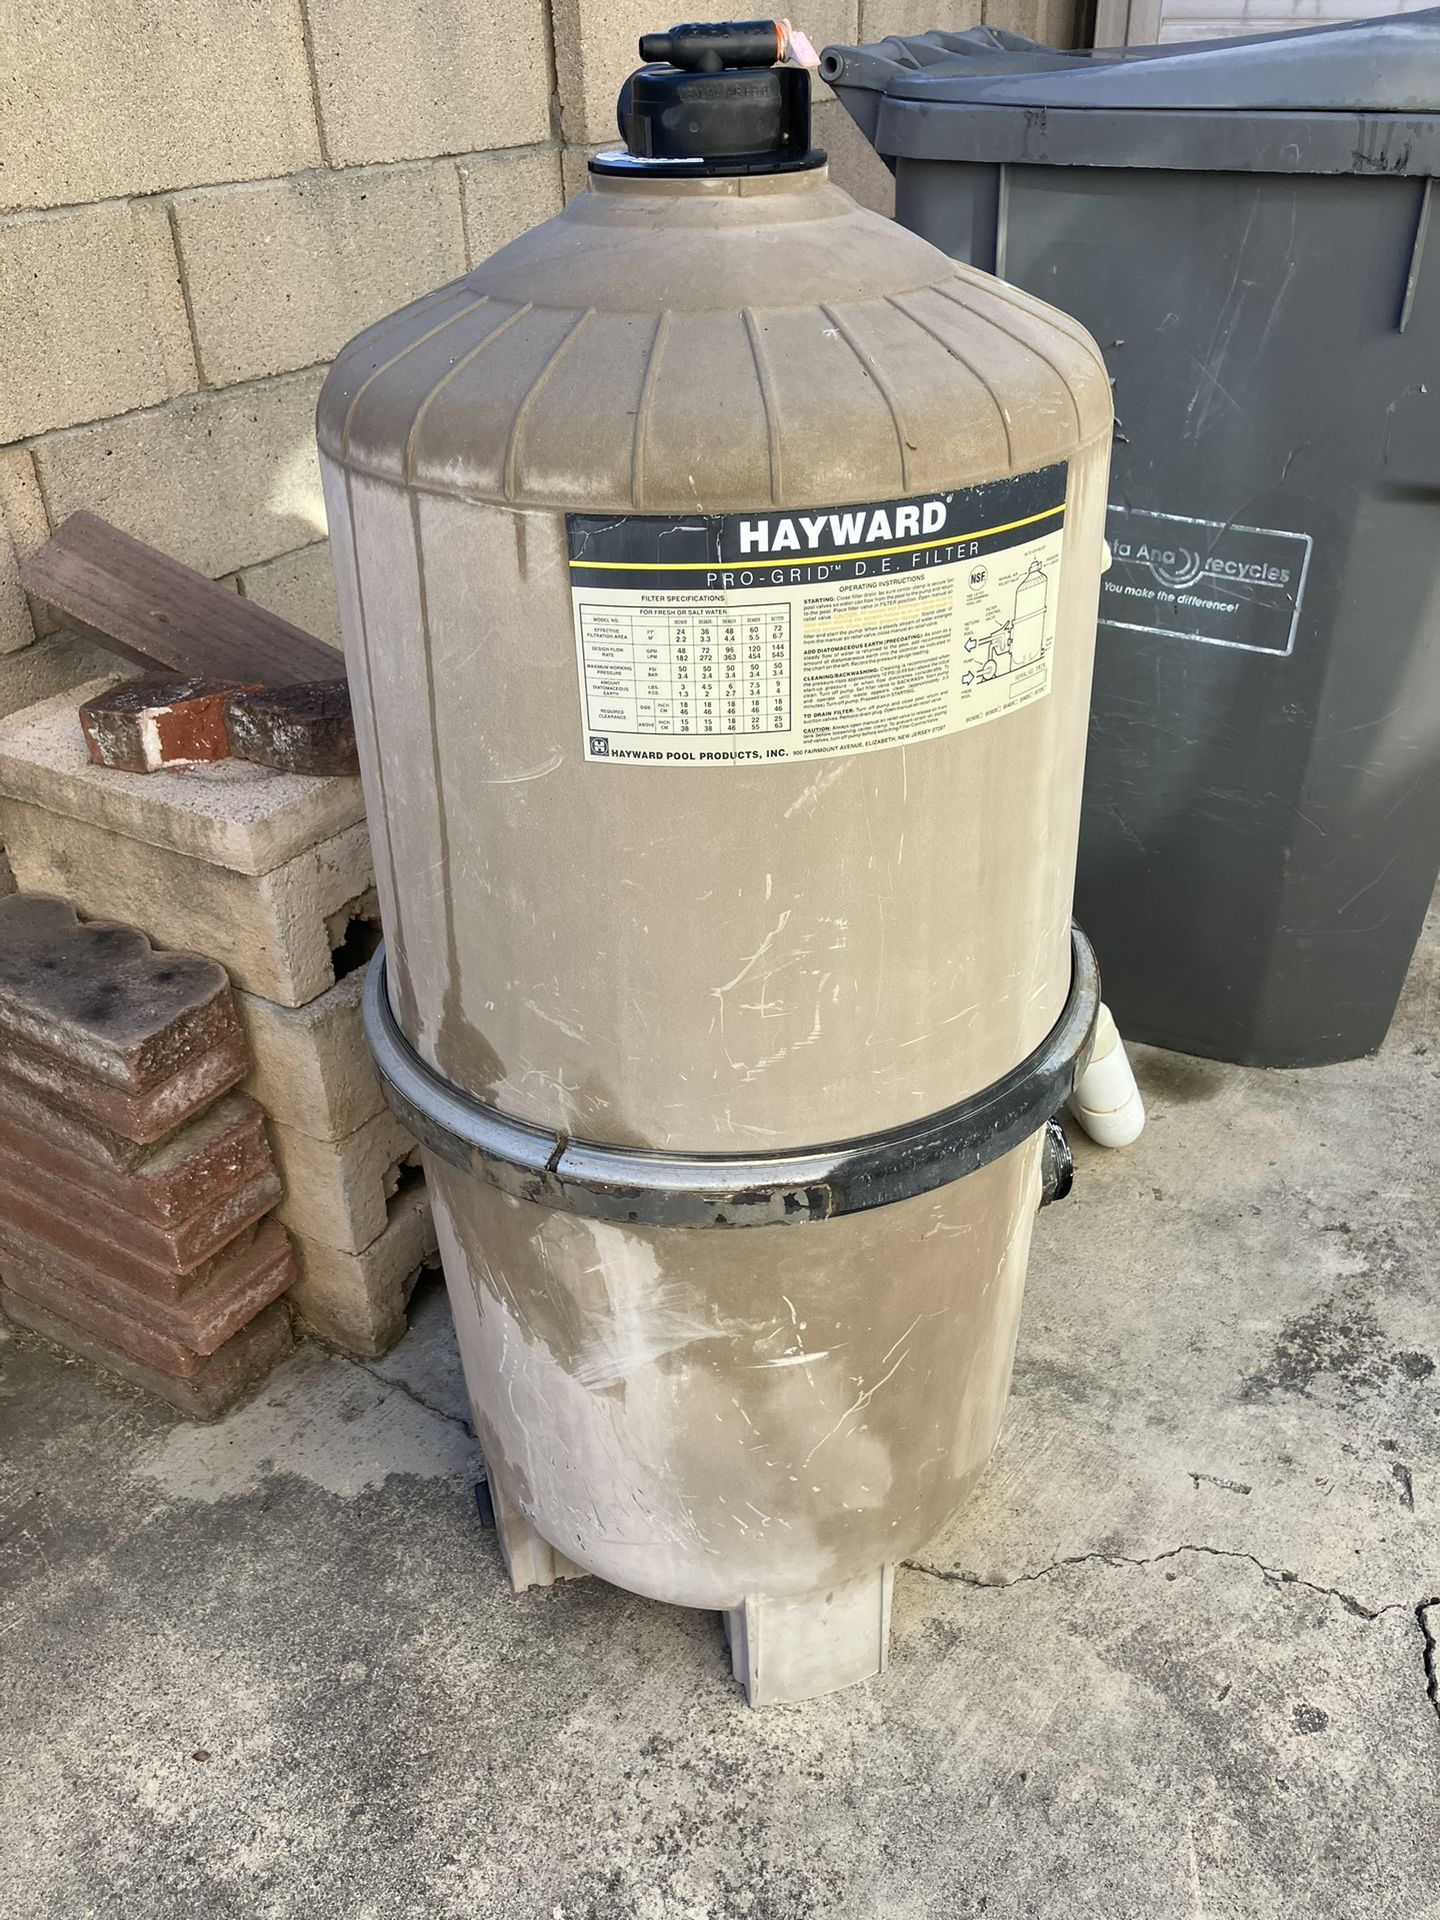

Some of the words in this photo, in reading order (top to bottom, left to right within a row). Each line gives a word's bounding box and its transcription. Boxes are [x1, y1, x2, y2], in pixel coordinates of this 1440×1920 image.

[740, 501, 947, 553] HAYWARD
[855, 558, 899, 576] D.E.
[912, 542, 979, 567] FILTER
[1137, 544, 1175, 564] Ana
[1204, 557, 1290, 582] recycles
[839, 582, 877, 592] OPERATING
[879, 574, 924, 587] INSTRUCTIONS
[971, 571, 985, 584] NSF
[1104, 581, 1122, 594] You
[1124, 585, 1155, 599] make
[1157, 590, 1175, 602] the
[1178, 594, 1239, 613] difference!
[817, 642, 863, 654] DIATOMACEOUS
[864, 640, 883, 648] EARTH
[611, 749, 663, 760] HAYWARD
[667, 752, 695, 760] POOL
[700, 750, 762, 760] PRODUCTS,
[767, 749, 788, 757] INC.
[804, 746, 838, 755] FAIRMOUNT
[911, 729, 931, 738] JERSEY
